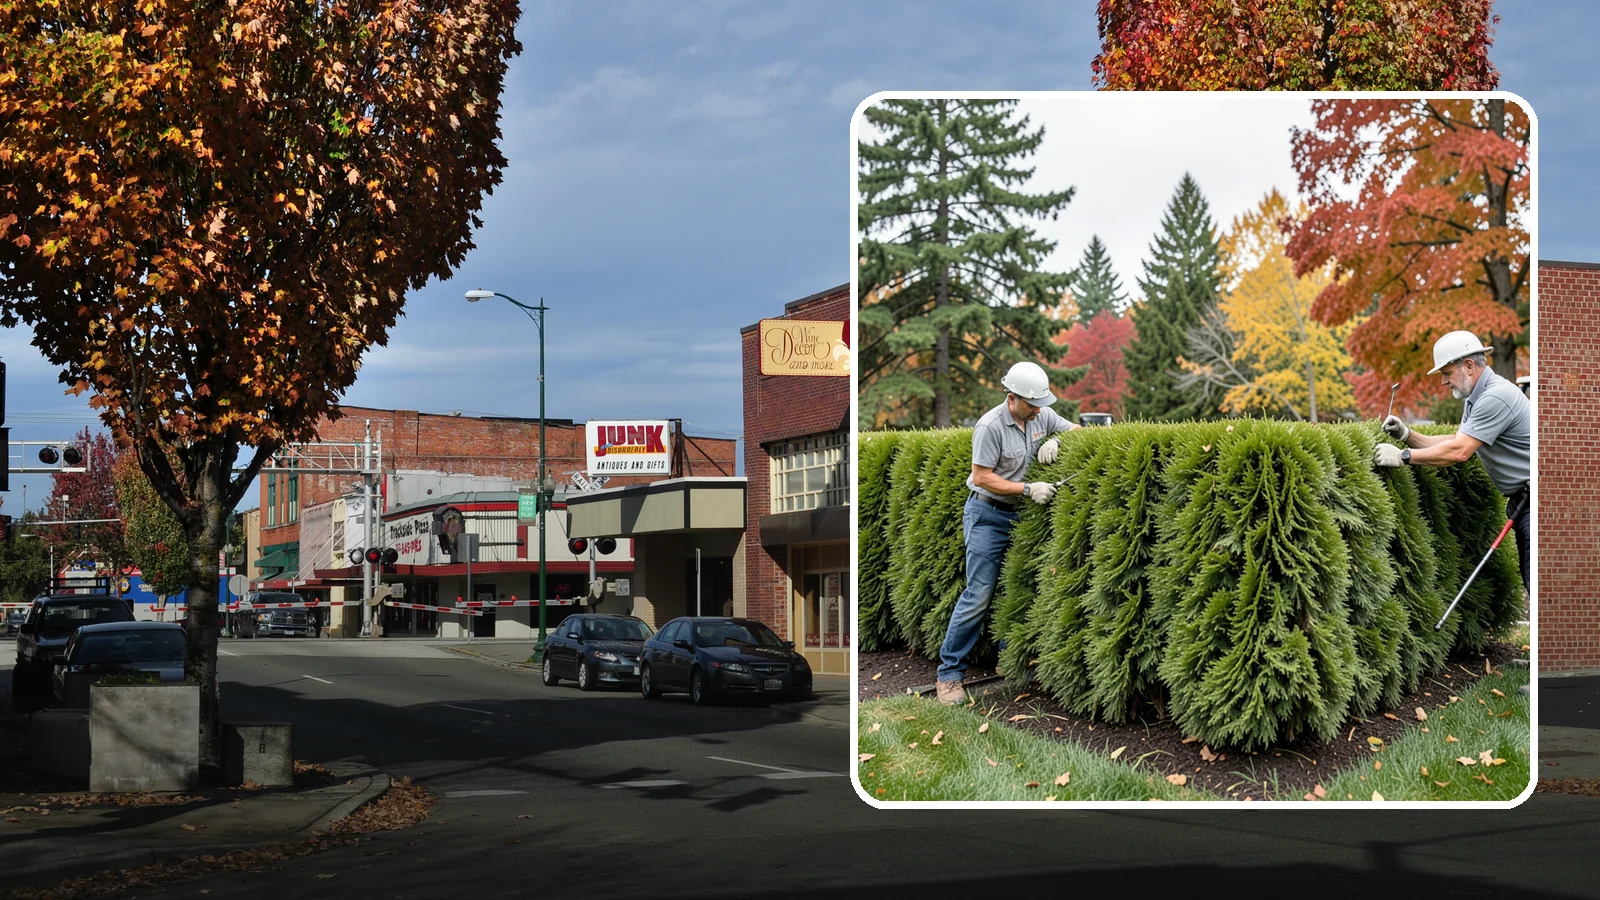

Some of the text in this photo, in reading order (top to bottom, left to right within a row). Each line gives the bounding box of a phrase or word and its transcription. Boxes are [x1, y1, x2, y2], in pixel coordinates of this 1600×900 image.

[596, 425, 665, 457] JUNK
[597, 460, 665, 470] ANTIQUES AND GIFTS
[573, 473, 588, 491] RAIL
[415, 519, 429, 535] Pizza
